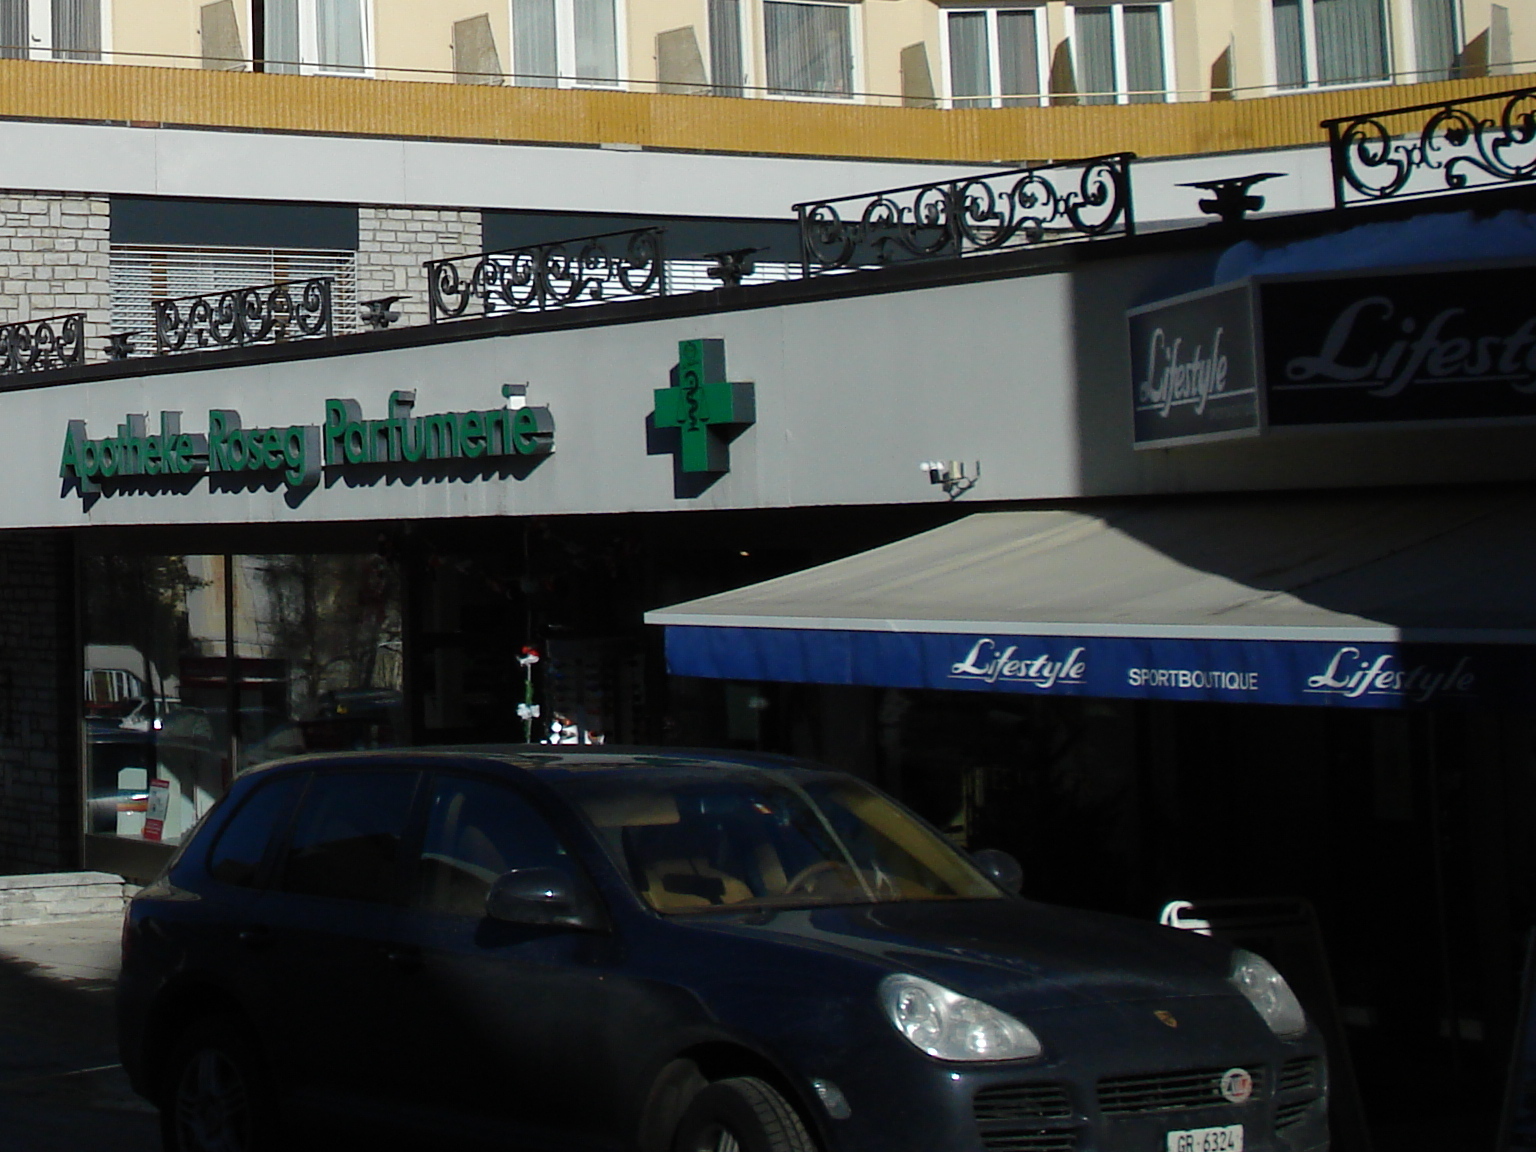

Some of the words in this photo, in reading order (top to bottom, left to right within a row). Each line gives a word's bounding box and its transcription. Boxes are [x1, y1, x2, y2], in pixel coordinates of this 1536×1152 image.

[1139, 327, 1228, 418] Lifestyle
[1285, 295, 1536, 397] Lifest
[60, 410, 202, 493] Apotheke
[208, 409, 312, 486] Roseg
[325, 383, 548, 465] Parfumerie
[951, 639, 1086, 688] Lifestyle
[1128, 668, 1260, 690] SPORTBOUTIQUE
[1307, 647, 1475, 702] Lifestyle
[1203, 1131, 1235, 1152] 6324
